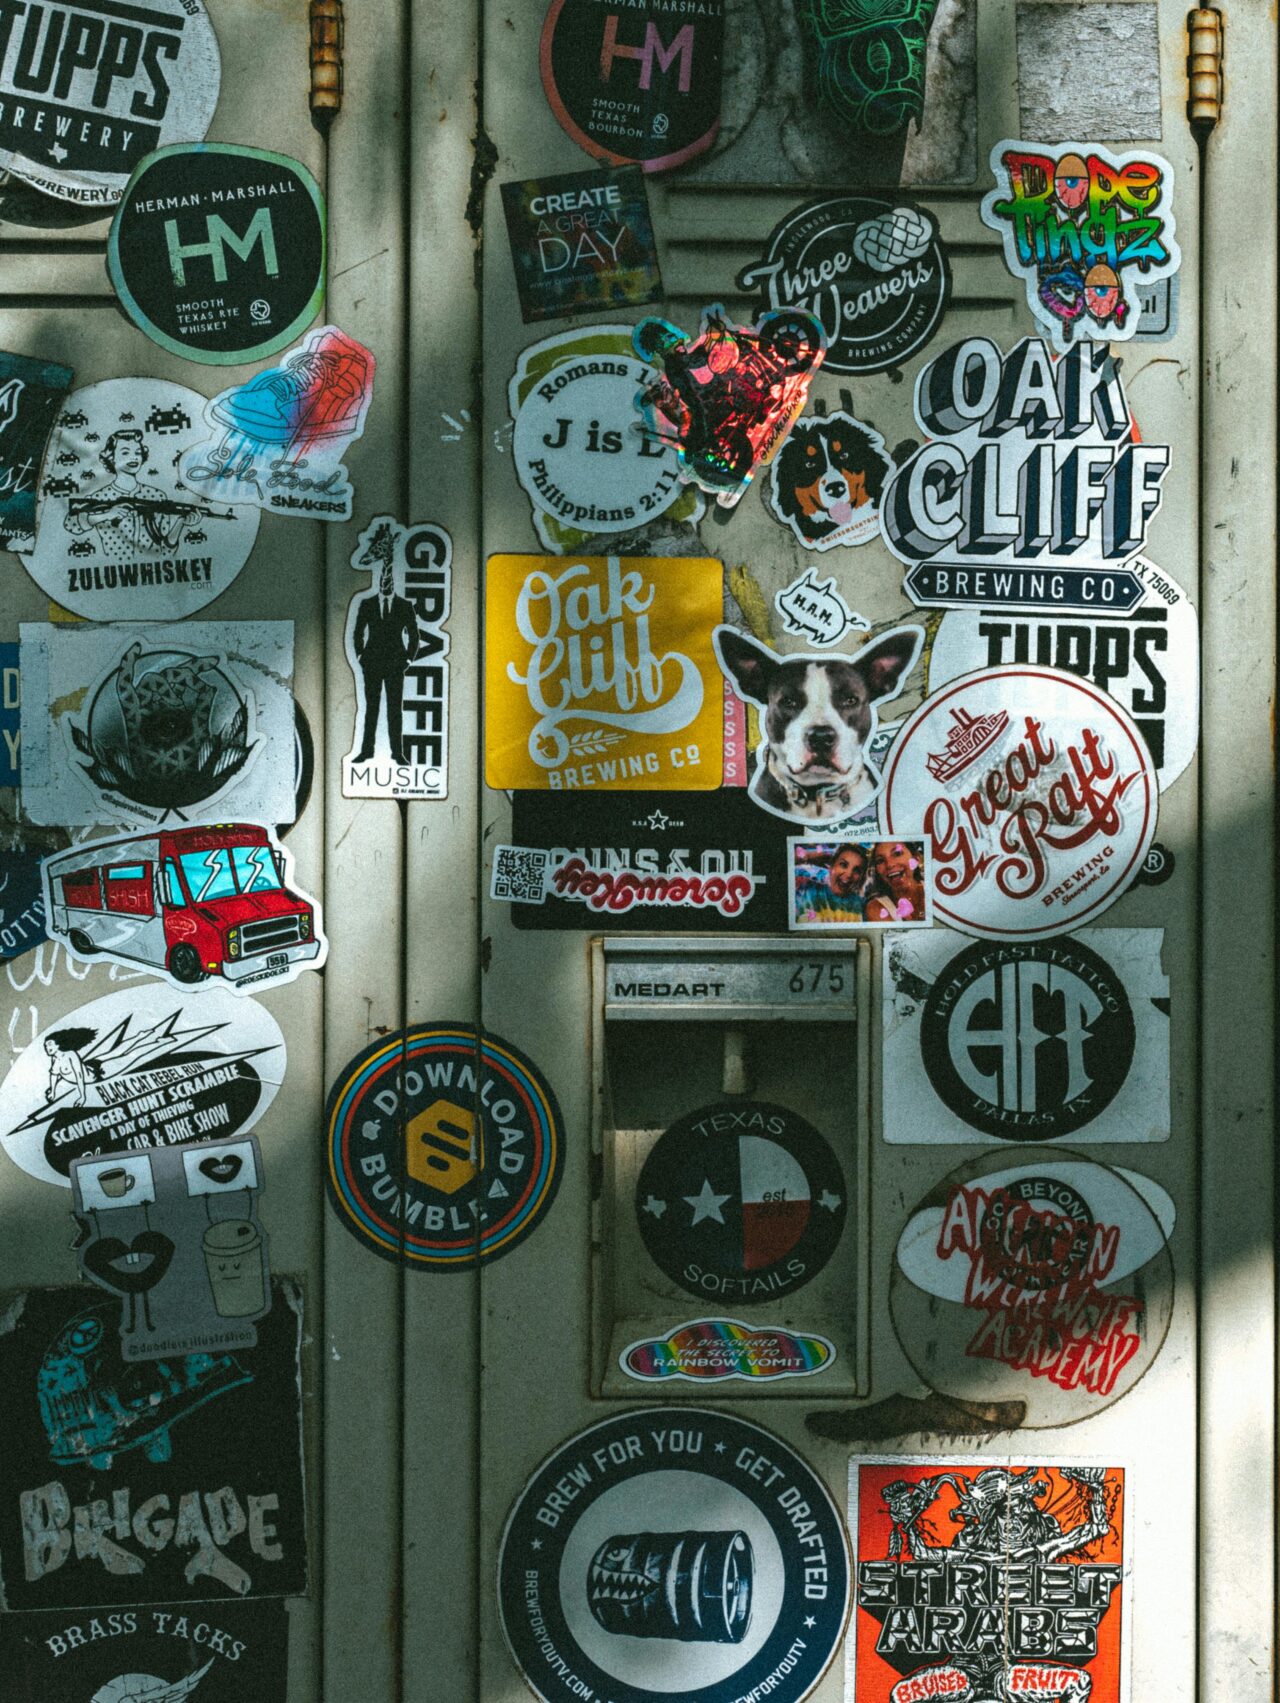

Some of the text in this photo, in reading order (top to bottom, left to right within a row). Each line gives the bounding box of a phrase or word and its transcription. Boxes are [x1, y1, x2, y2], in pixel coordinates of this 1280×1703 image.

[600, 15, 695, 92] HM
[591, 109, 627, 123] TEXAS
[592, 98, 640, 114] SMOOTH
[588, 121, 643, 139] BOURBON
[135, 181, 296, 214] HERMAN MARSHALL
[529, 185, 621, 216] CREATE
[536, 207, 621, 236] A GREAT
[165, 207, 279, 287] HM
[538, 226, 626, 273] DAY
[743, 250, 852, 309] Three
[176, 298, 225, 312] SMOOTH
[178, 308, 240, 325] TEXAS RYE
[795, 262, 934, 350] Weavers
[179, 321, 228, 335] WHISKEY
[848, 303, 927, 358] BREWING COMPANY
[537, 361, 628, 403] Romans
[919, 337, 1131, 439] OAK
[542, 418, 573, 449] J
[585, 421, 623, 454] is
[271, 495, 346, 514] SNEAKERS
[528, 458, 679, 522] Philippians 2:11
[883, 442, 1171, 560] CLIFF
[68, 558, 213, 592] ZULUWHISKEY
[935, 571, 1115, 601] BREWING CO
[1132, 562, 1180, 606] TX 75069
[516, 557, 655, 642] Oak
[350, 767, 441, 788] MUSIC
[548, 751, 659, 789] BREWING
[923, 716, 1055, 895] Great
[996, 728, 1142, 899] Raft
[1042, 846, 1115, 907] BREWING
[615, 964, 844, 997] MEDART 675
[936, 946, 1122, 1017] HOLD FAST TATTOO
[52, 1063, 240, 1147] SCAVENGER HUNT SCRAMBLE
[98, 1062, 204, 1106] BLACK CAT REBEL RUN
[117, 1100, 195, 1138] DAY OF THIEVING
[127, 1103, 230, 1150] CAR BIKE SHOW
[374, 1060, 527, 1176] DOWNLOAD
[691, 1111, 786, 1138] TEXAS
[972, 1096, 1091, 1125] DALLAS TX
[360, 1152, 490, 1232] BUMBLE
[762, 1188, 787, 1202] est
[683, 1259, 806, 1294] SOFTAILS
[653, 1357, 803, 1368] RAINBOW VOMIT
[677, 1348, 756, 1358] THE SECRET
[696, 1337, 778, 1348] DISCOVERED
[536, 1430, 829, 1601] BREW FOR YOU GET DRAFTED
[19, 1481, 284, 1594] BRIGADE
[858, 1561, 1124, 1608] STREET
[45, 1612, 246, 1661] BRASS TACKS
[525, 1569, 595, 1701] BREWFORYOUTV.COM
[876, 1607, 1100, 1656] ARABS
[896, 1669, 1079, 1703] BRUISED FRUIT
